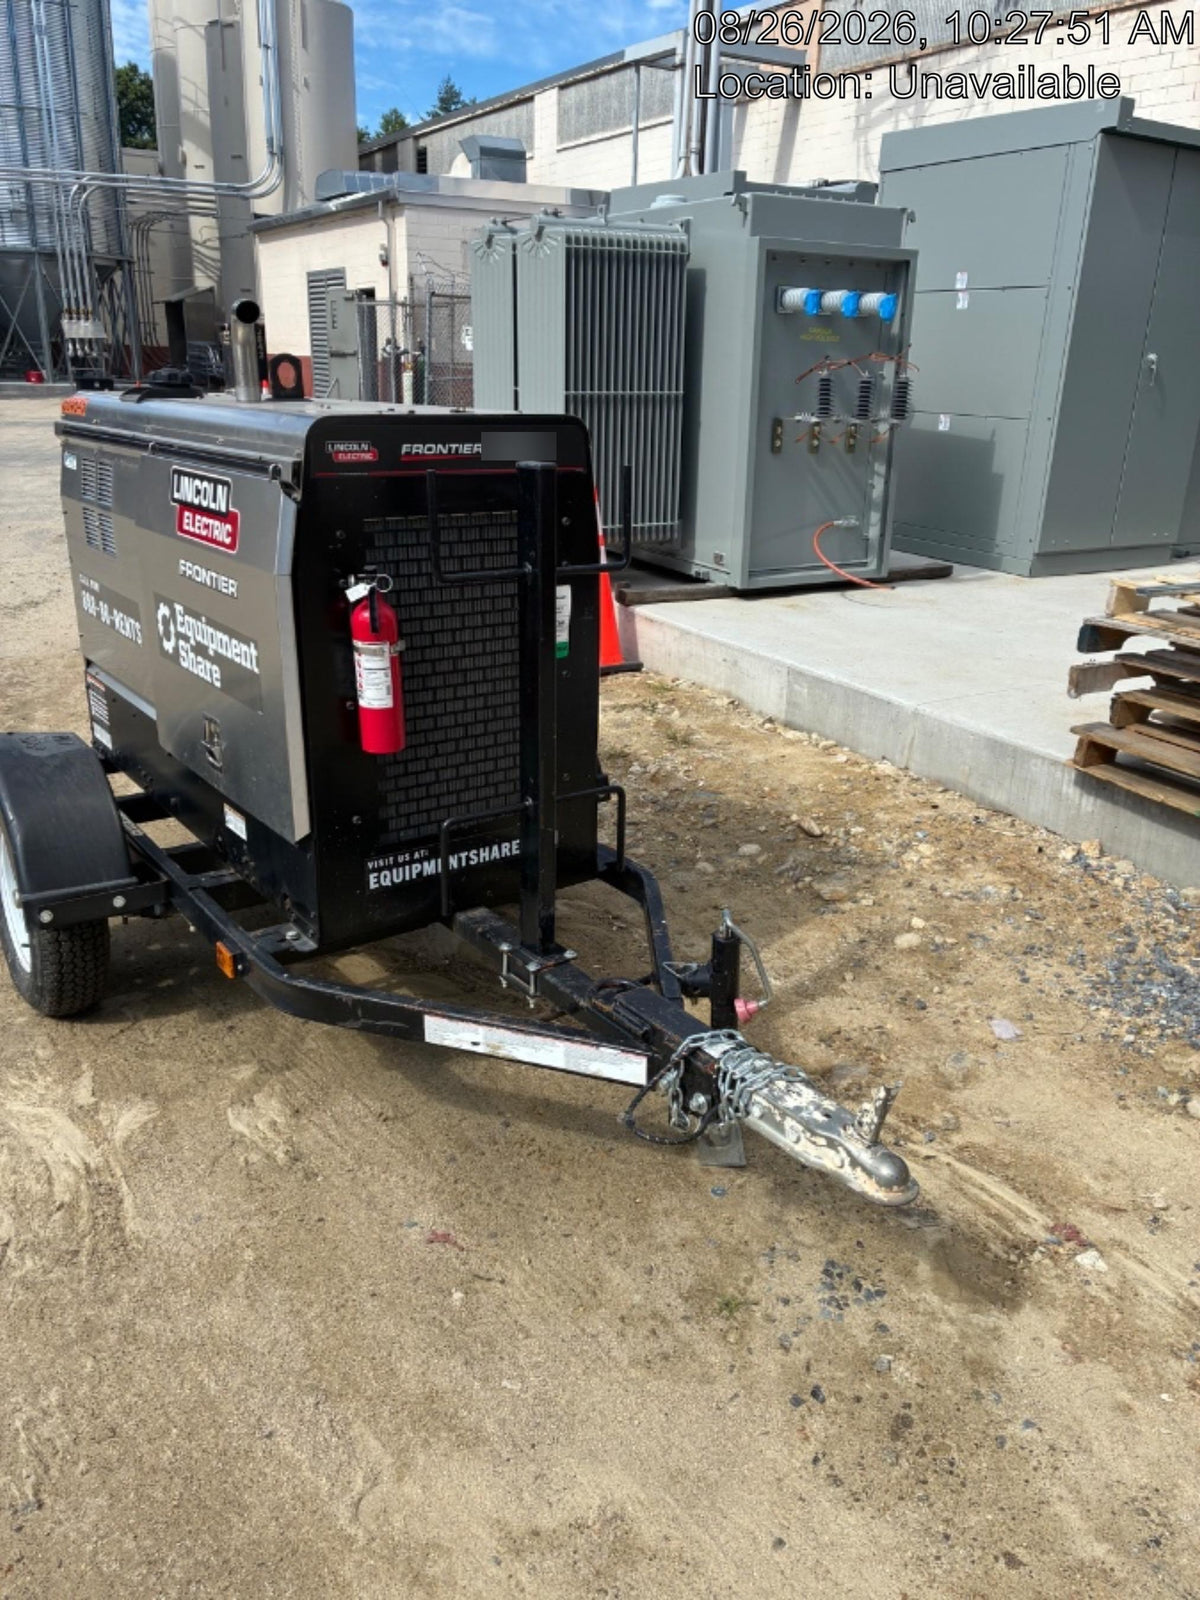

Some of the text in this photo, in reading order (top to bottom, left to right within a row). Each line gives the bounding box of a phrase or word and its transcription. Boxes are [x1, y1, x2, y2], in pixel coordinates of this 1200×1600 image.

[327, 442, 369, 452] LINCOLN
[338, 452, 373, 460] ELECTRIC
[401, 443, 482, 455] FRONTIER
[173, 473, 228, 513] LINCOLN
[183, 510, 232, 545] ELECTRIC
[179, 559, 238, 598] FRONTIER
[174, 603, 260, 675] Equipment
[178, 639, 222, 688] Share
[367, 855, 394, 870] VISIT
[399, 852, 410, 863] US
